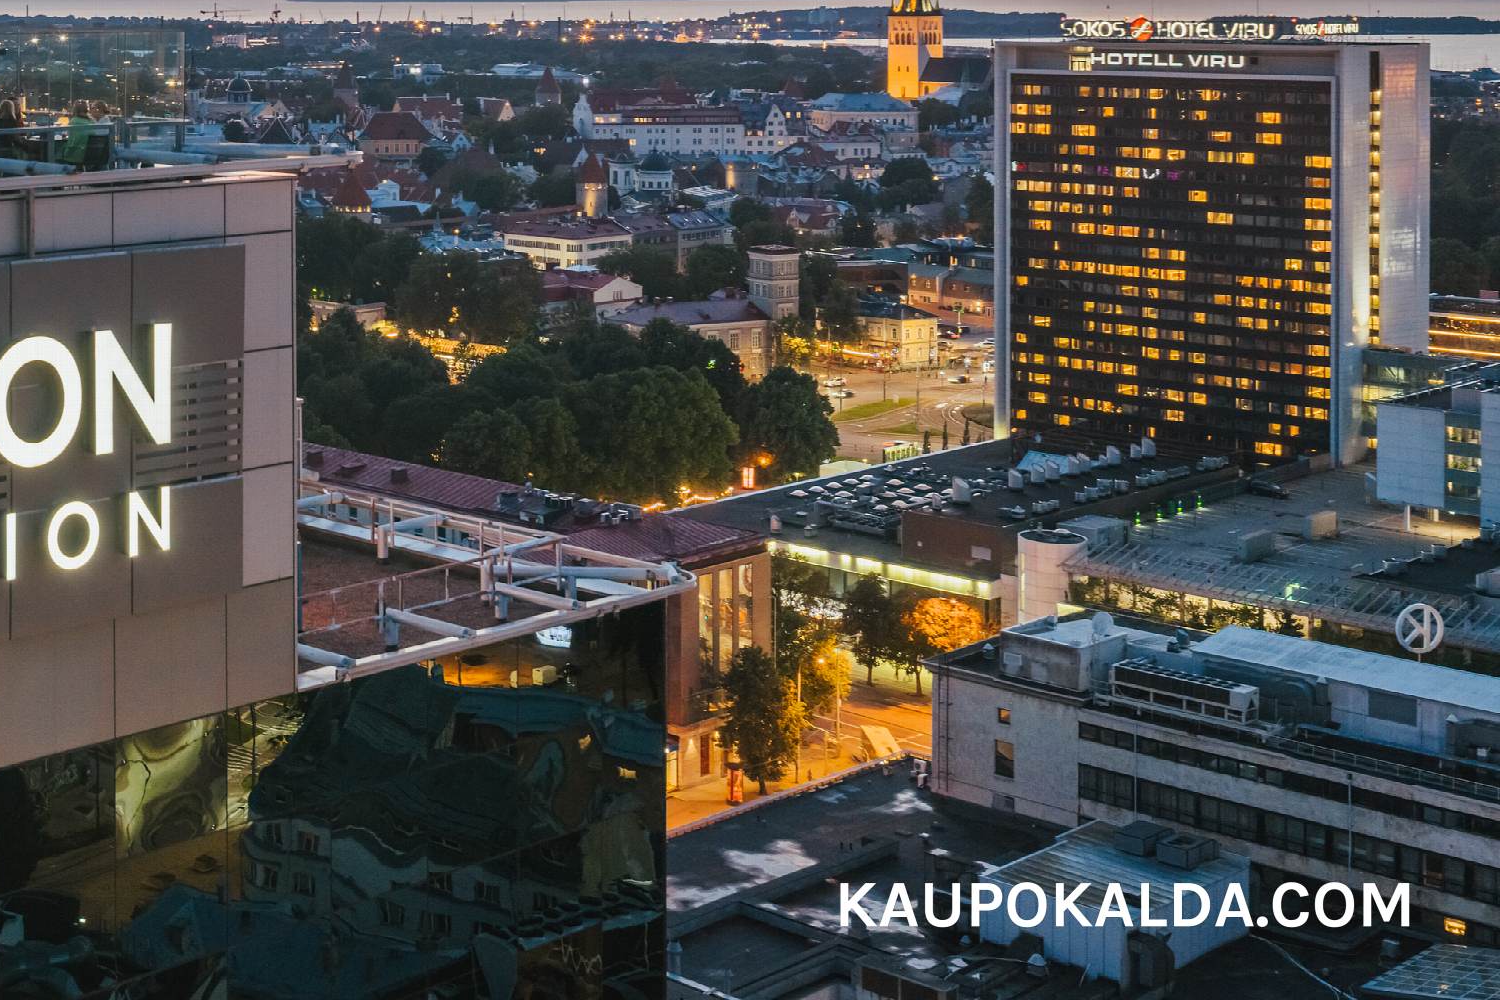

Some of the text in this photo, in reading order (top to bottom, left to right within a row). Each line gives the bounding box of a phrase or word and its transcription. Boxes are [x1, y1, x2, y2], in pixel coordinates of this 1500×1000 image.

[1060, 21, 1275, 40] SOKOS HOTEL VIRU
[1090, 52, 1245, 68] HOTELL VIRU
